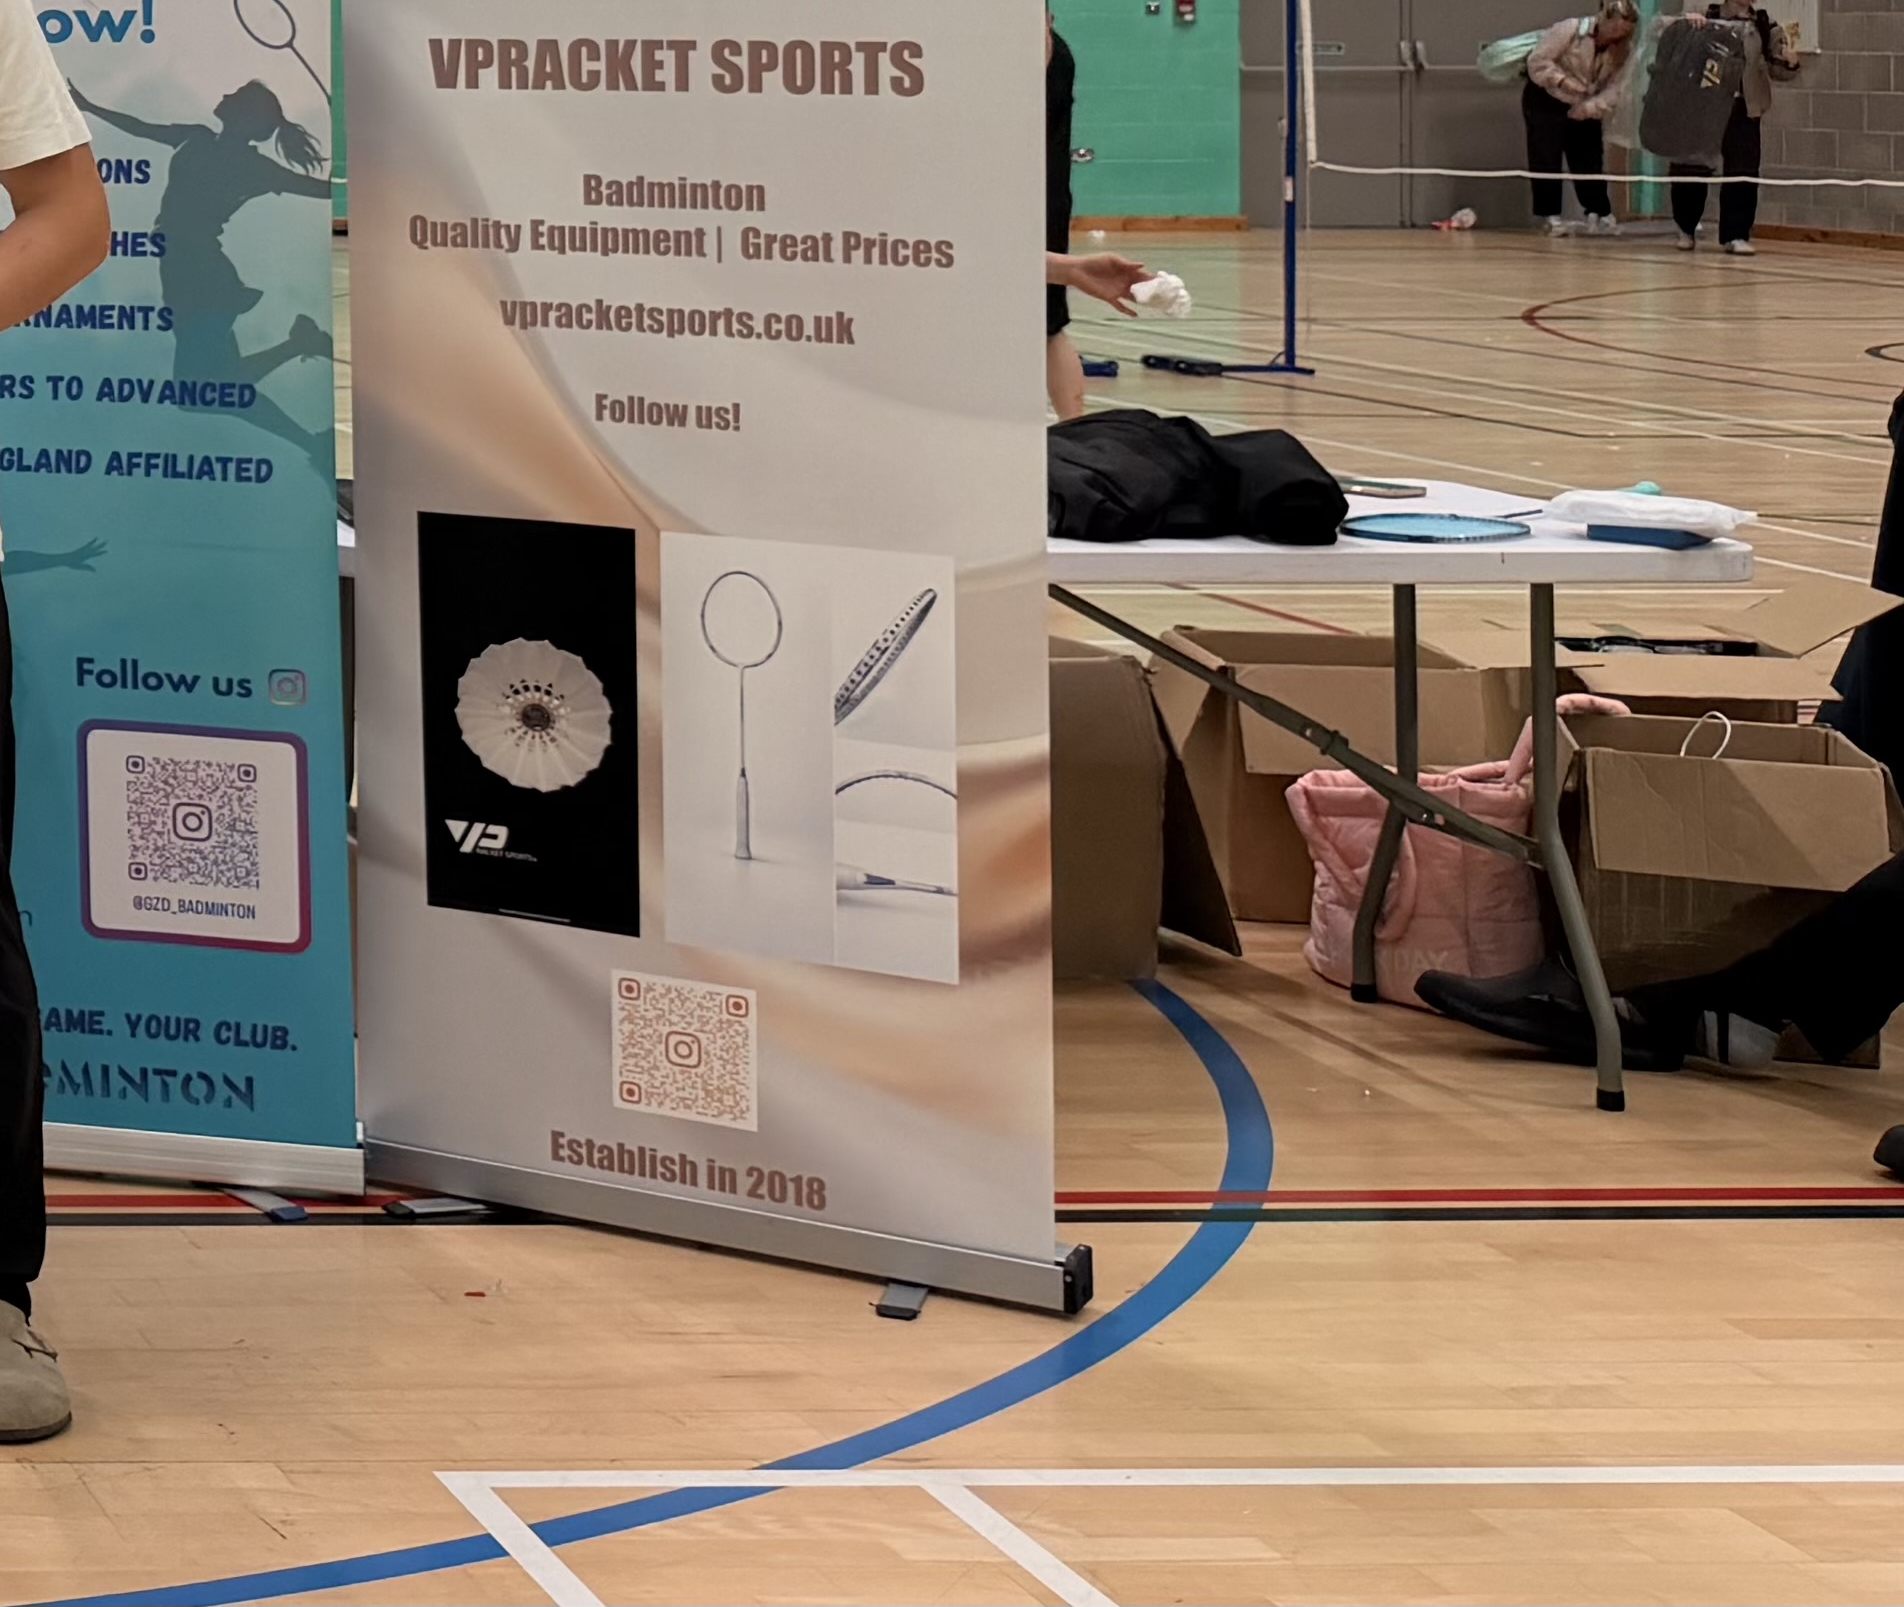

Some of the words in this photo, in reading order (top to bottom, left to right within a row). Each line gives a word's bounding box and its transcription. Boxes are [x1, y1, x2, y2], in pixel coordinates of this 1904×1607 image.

[429, 38, 697, 92] VPRACKET
[711, 39, 924, 97] SPORTS
[583, 174, 765, 211] Badminton
[410, 215, 521, 252] Quality
[530, 220, 707, 257] Equipment
[741, 227, 834, 263] Great
[842, 231, 954, 268] Prices
[500, 299, 855, 345] vpracketsports.co.uk
[46, 375, 83, 401] TO
[96, 378, 256, 409] ADVANCED
[596, 394, 688, 427] Follow
[696, 403, 740, 431] us!
[105, 451, 273, 483] AFFILIATED
[77, 657, 200, 693] Follow
[213, 677, 252, 698] us
[133, 896, 255, 919] @GZD_BADMINTON
[125, 1013, 200, 1042] YOUR
[214, 1021, 297, 1051] CLUB.
[551, 1130, 698, 1187] Establish
[707, 1159, 737, 1194] in
[746, 1166, 826, 1210] 2018
